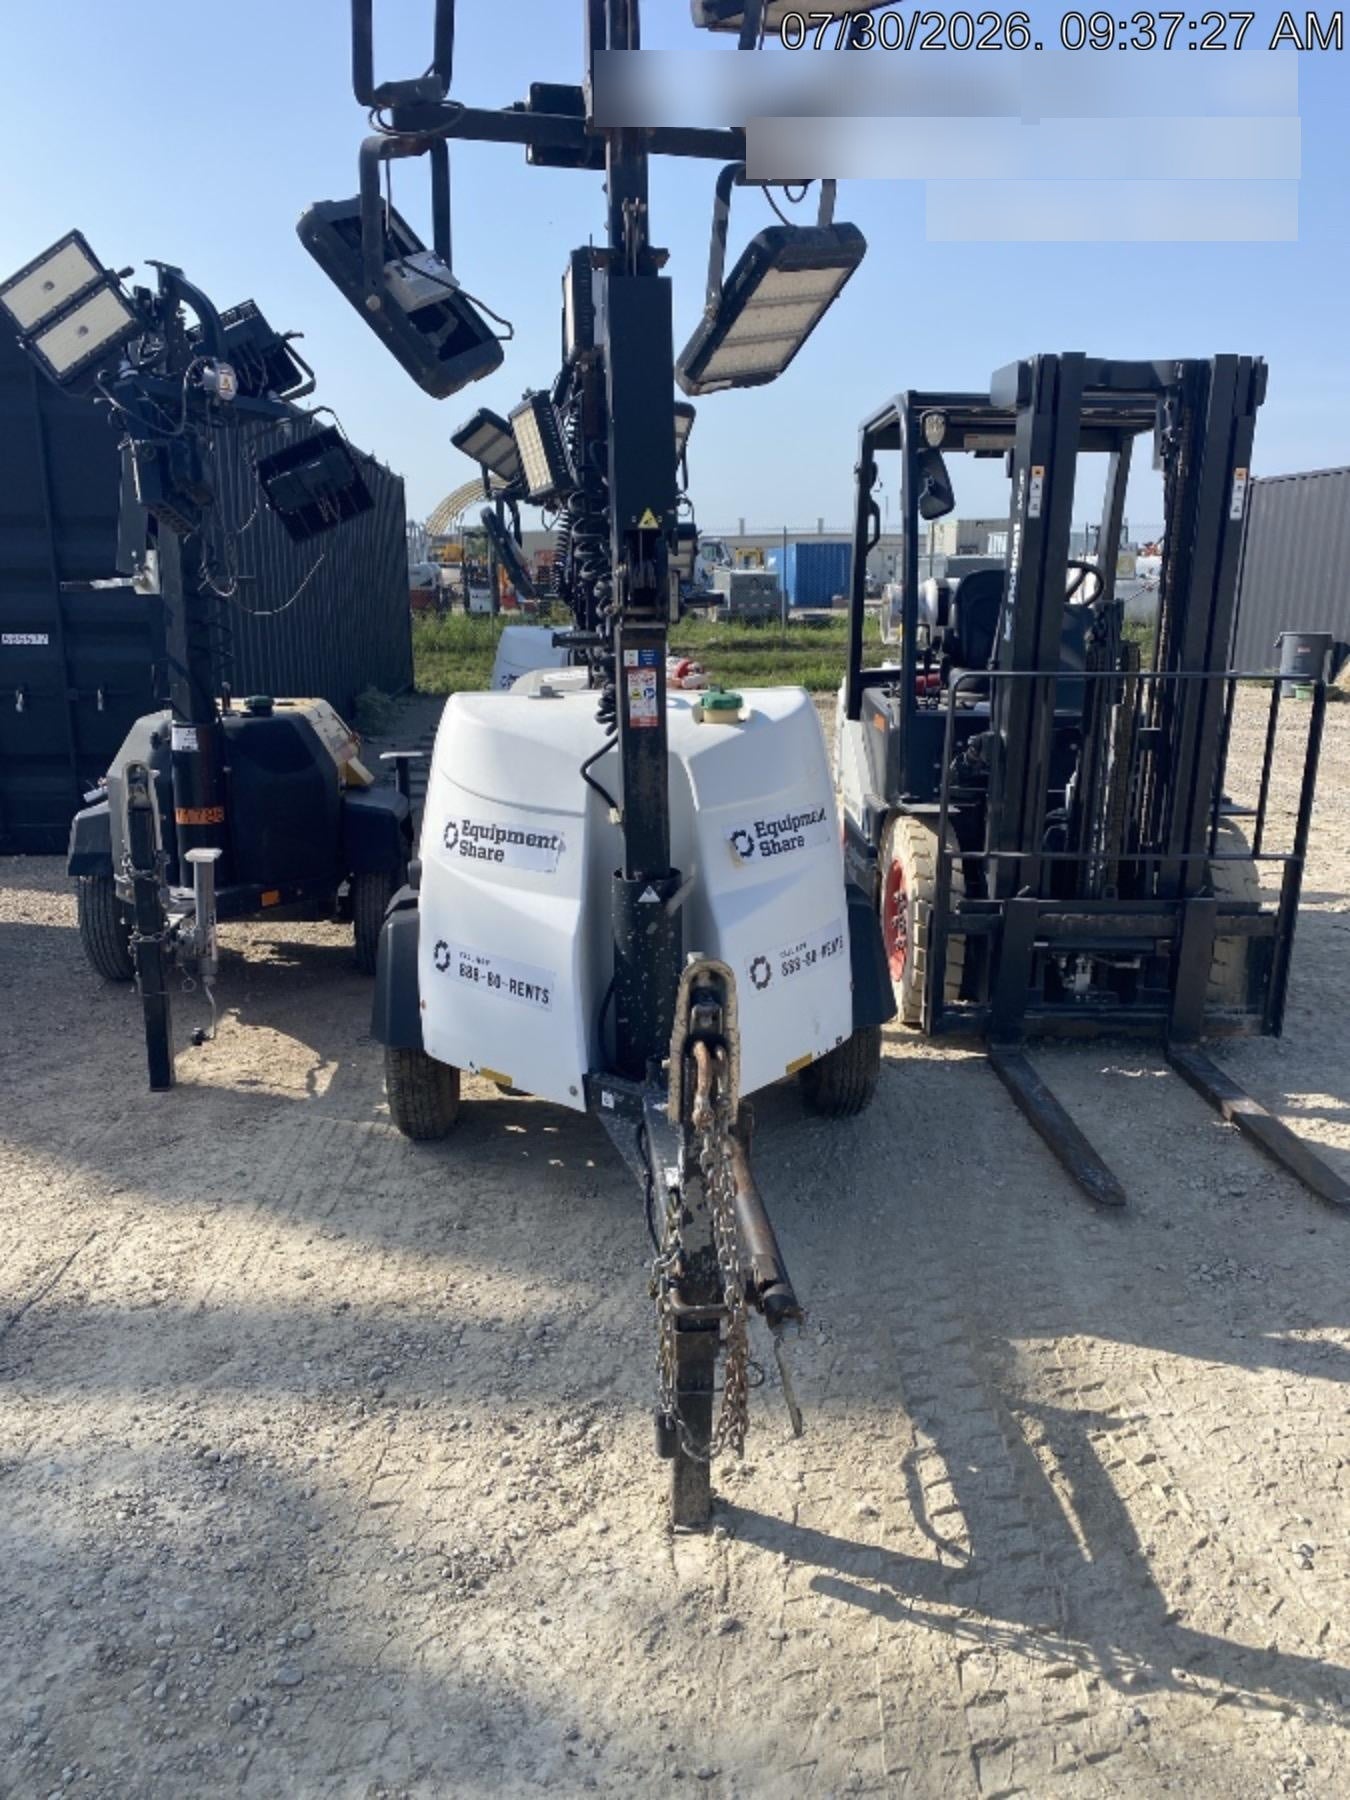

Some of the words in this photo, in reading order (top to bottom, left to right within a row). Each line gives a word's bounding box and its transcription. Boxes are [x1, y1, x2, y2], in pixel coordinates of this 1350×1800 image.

[461, 819, 559, 850] Equipment
[760, 835, 805, 857] Share
[459, 839, 505, 862] Share
